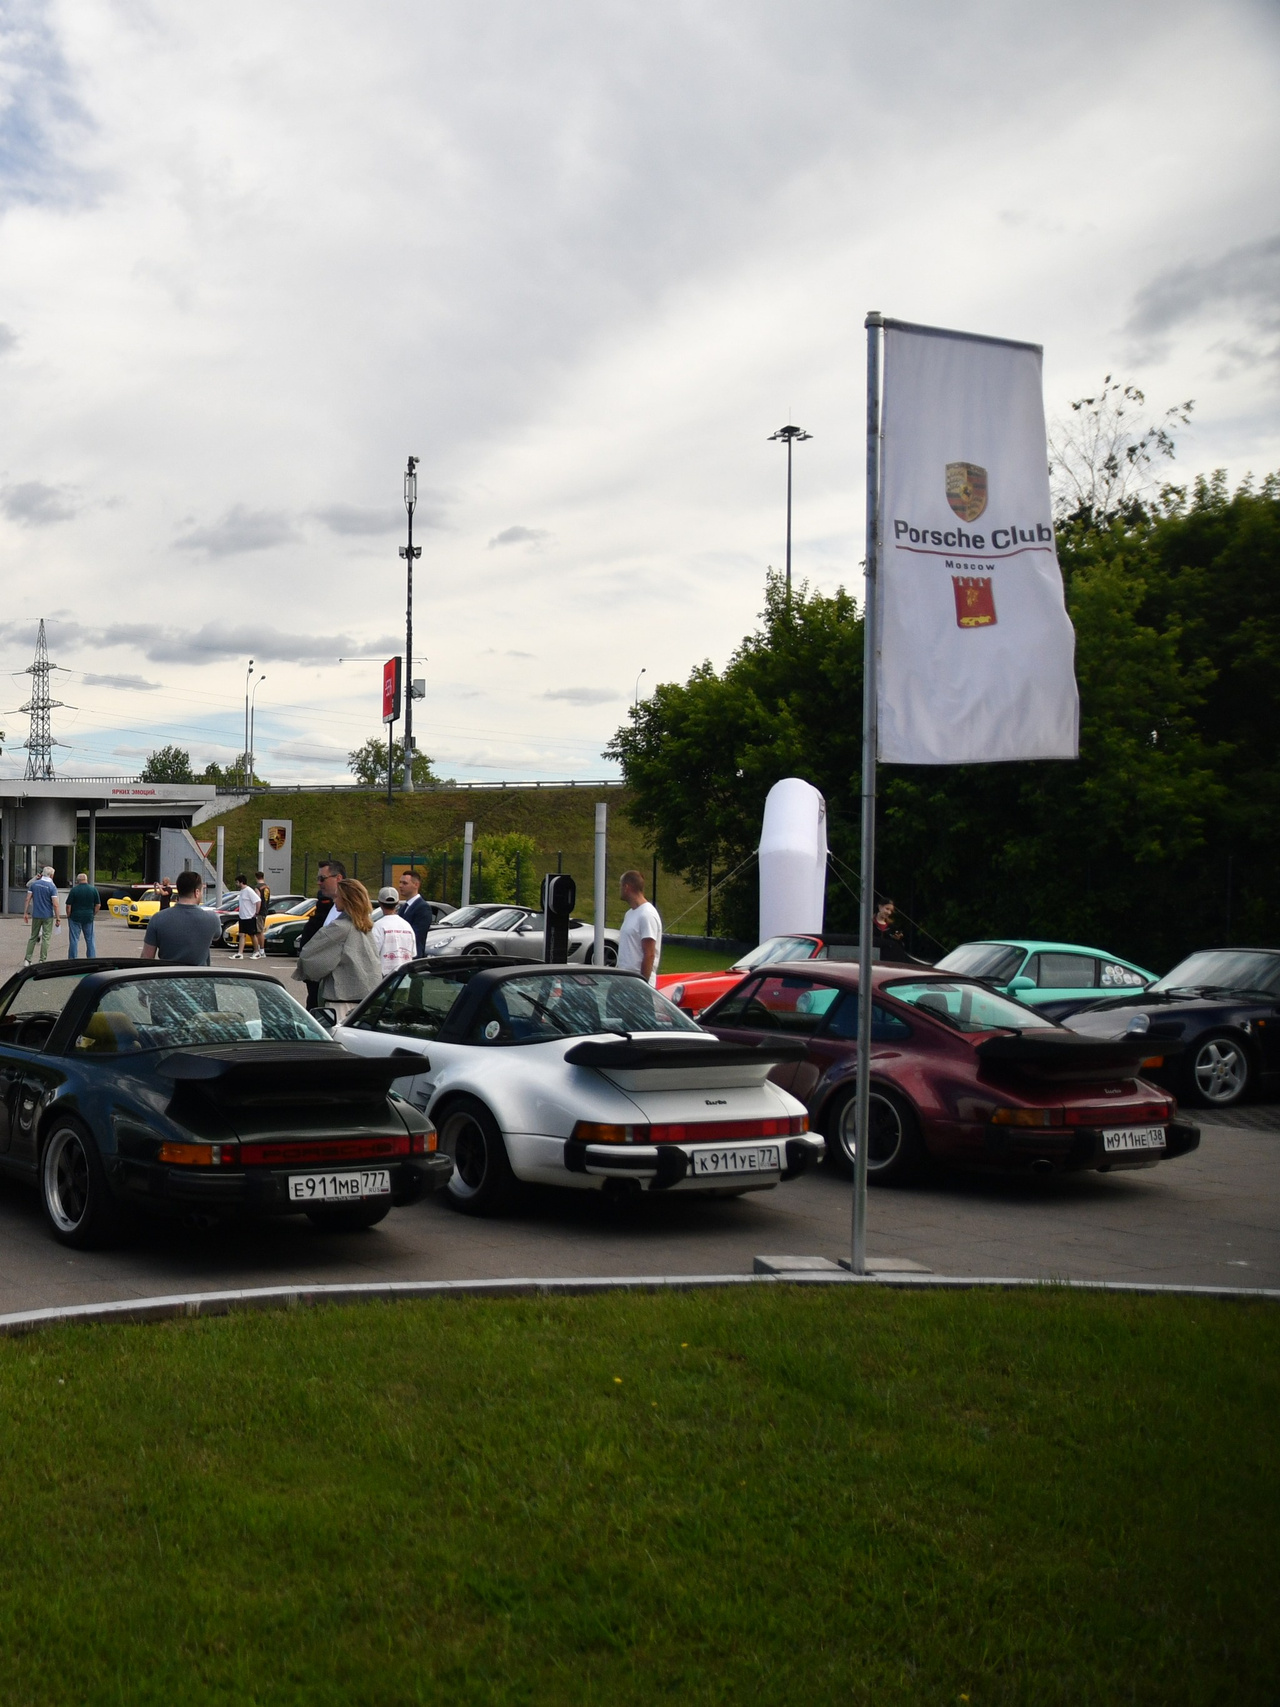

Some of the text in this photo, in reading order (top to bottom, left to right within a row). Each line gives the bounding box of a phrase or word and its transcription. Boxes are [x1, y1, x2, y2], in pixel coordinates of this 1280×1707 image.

[894, 519, 1052, 549] Porsche Club
[945, 560, 995, 570] Moscow
[1148, 1129, 1163, 1140] 138
[759, 1149, 773, 1162] 77
[362, 1172, 385, 1187] 777
